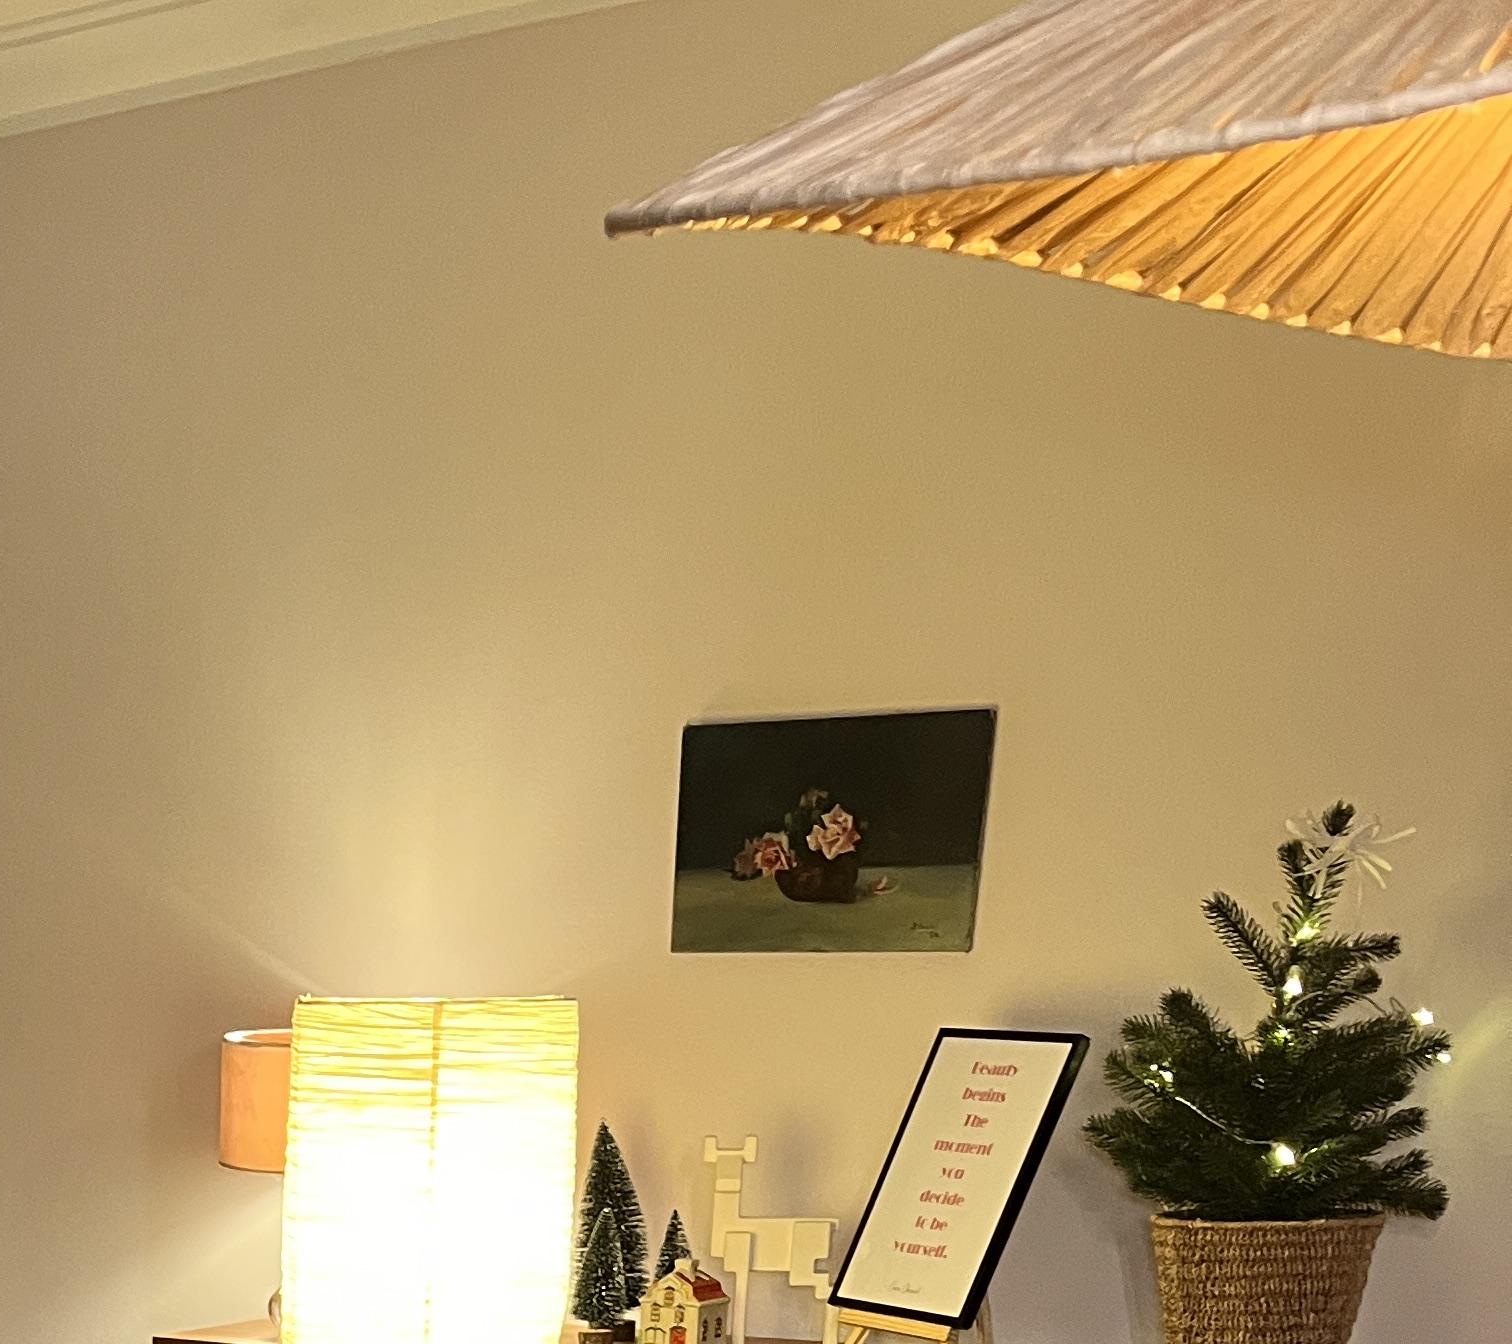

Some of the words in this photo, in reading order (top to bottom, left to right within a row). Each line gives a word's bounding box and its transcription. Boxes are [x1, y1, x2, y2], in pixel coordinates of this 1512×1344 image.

[933, 1139, 994, 1157] moment
[941, 1167, 965, 1181] you
[919, 1189, 965, 1207] decide
